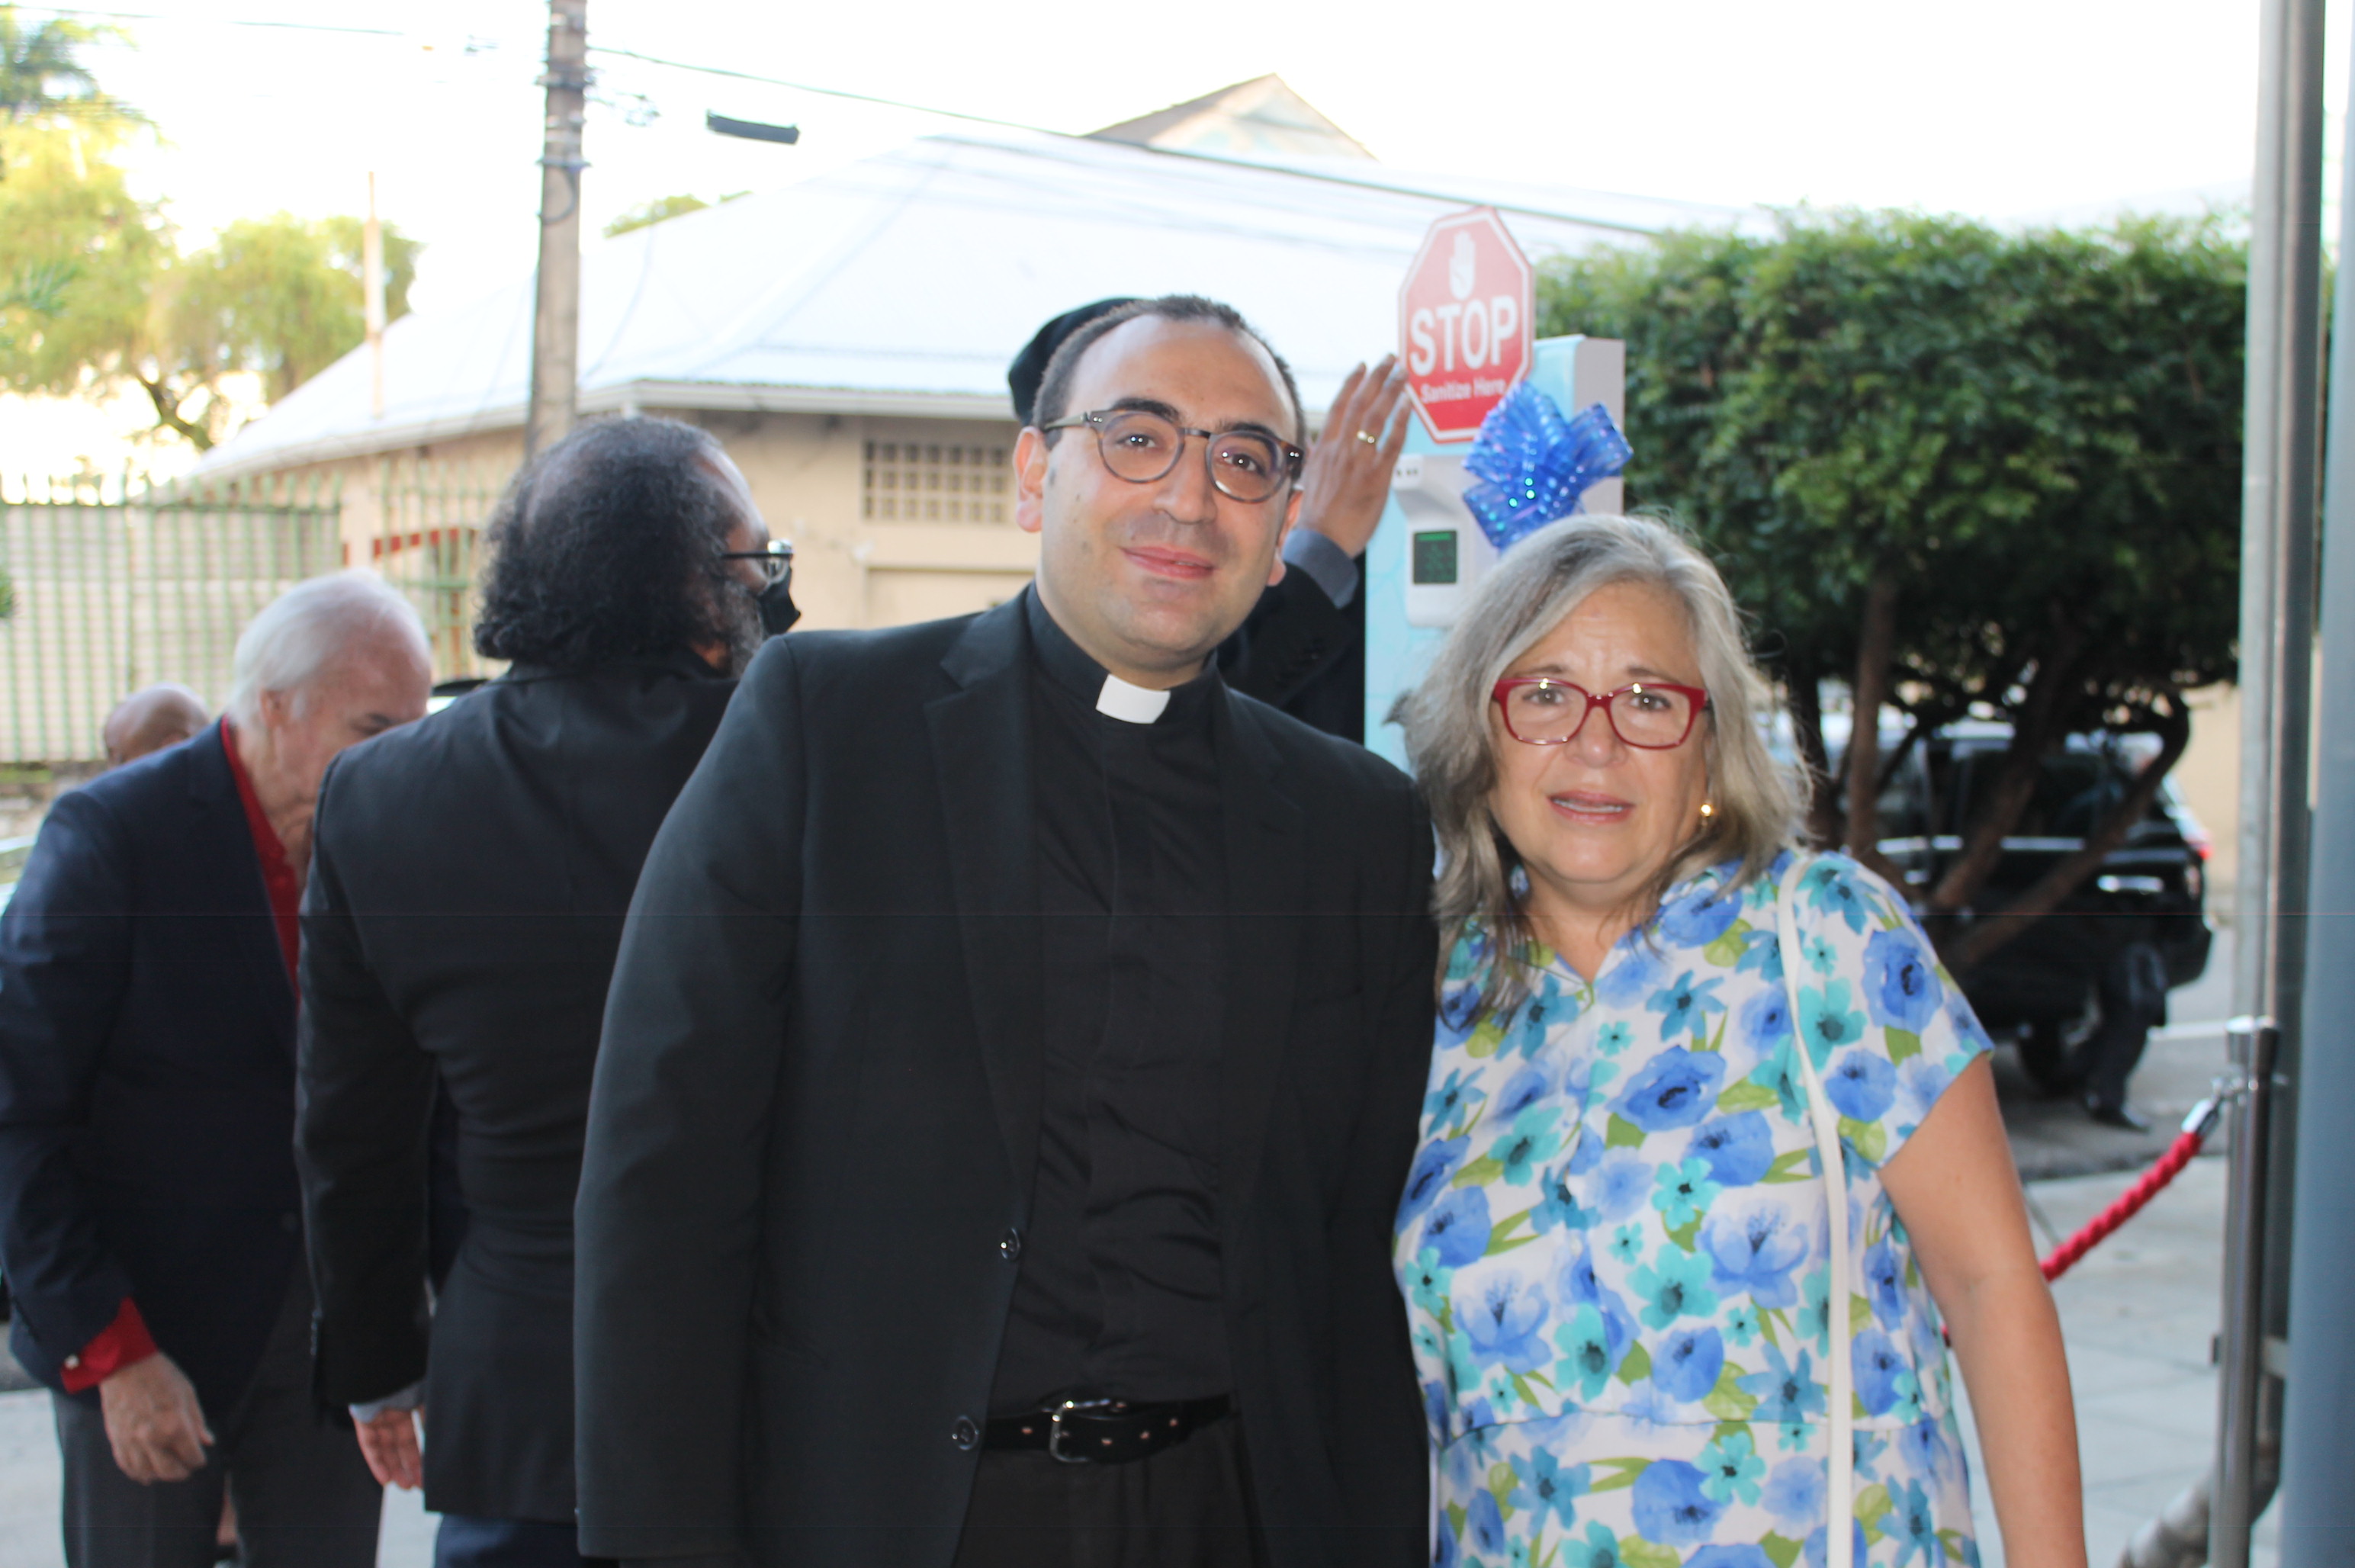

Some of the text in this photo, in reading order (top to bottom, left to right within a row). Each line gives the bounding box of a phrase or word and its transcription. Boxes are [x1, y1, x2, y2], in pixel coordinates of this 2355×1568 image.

[1410, 296, 1518, 376] STOP
[1420, 377, 1506, 403] Sanitize Here
